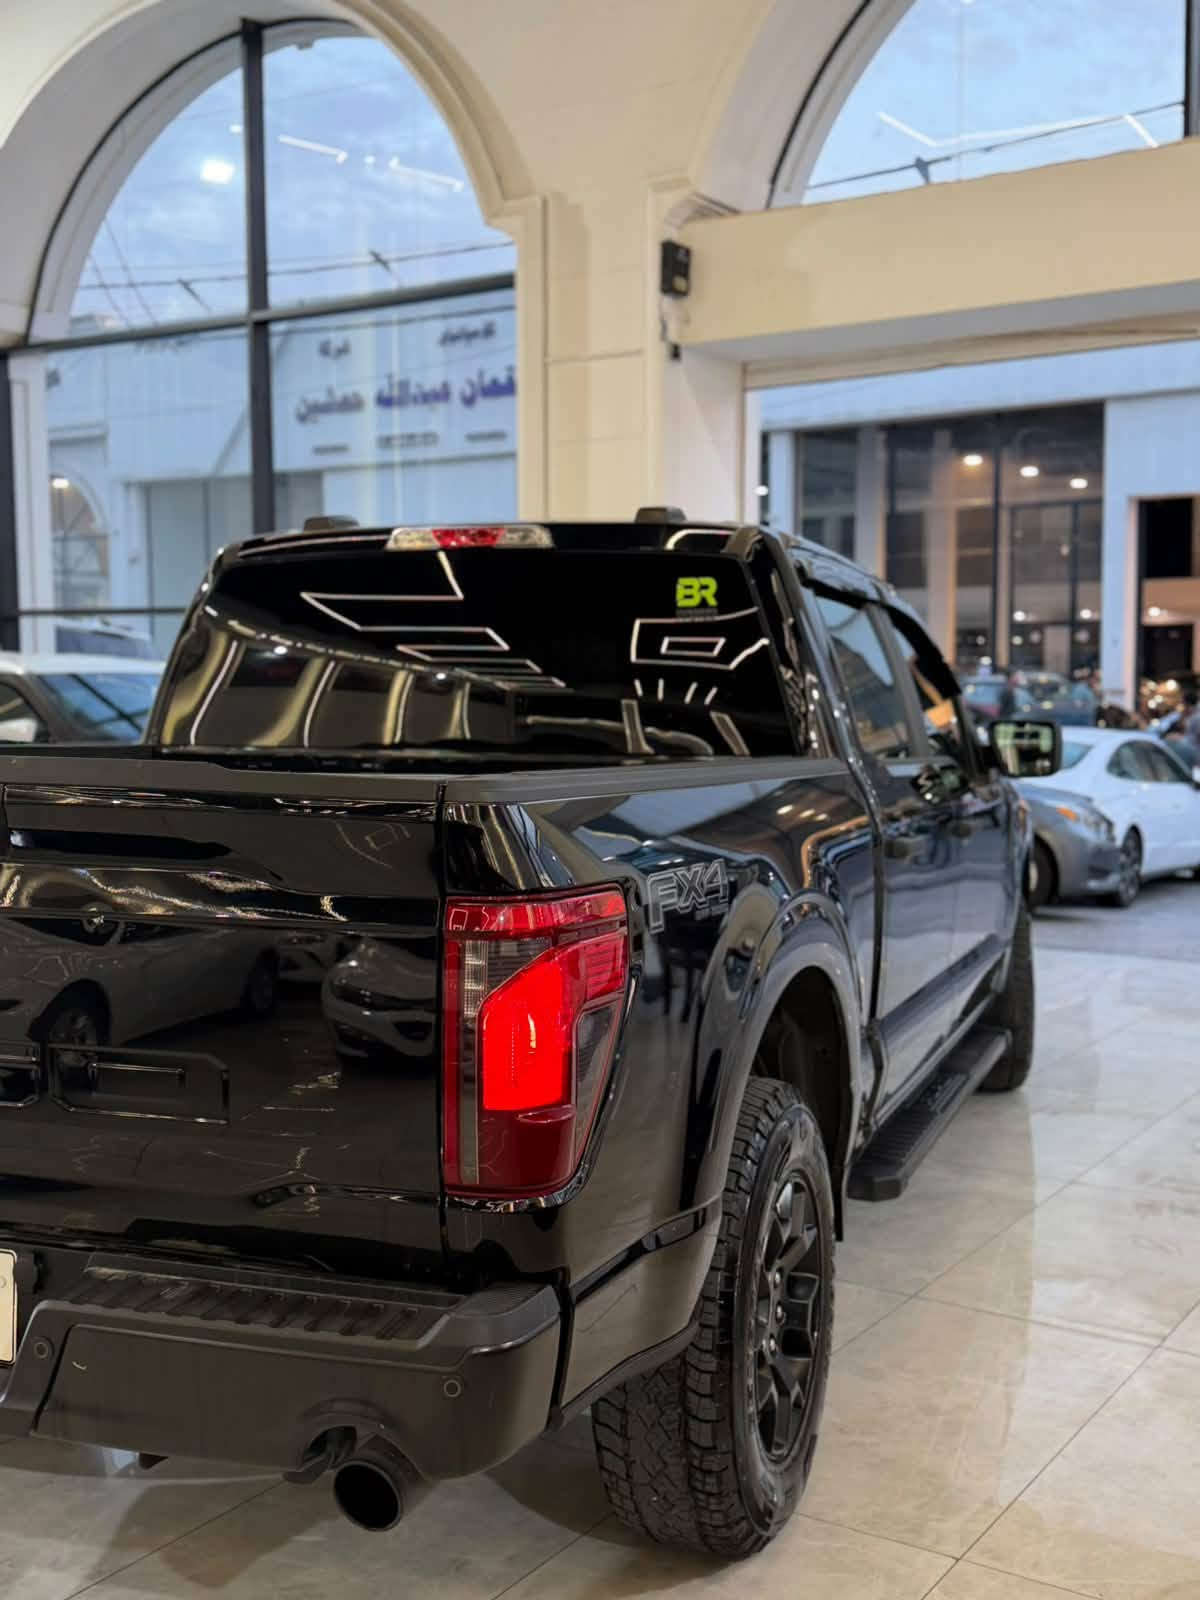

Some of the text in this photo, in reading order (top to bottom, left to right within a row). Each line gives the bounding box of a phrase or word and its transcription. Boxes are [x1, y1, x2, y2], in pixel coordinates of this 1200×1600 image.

[376, 372, 450, 411] عبدالله
[676, 577, 718, 607] BR
[645, 859, 729, 934] FX4
